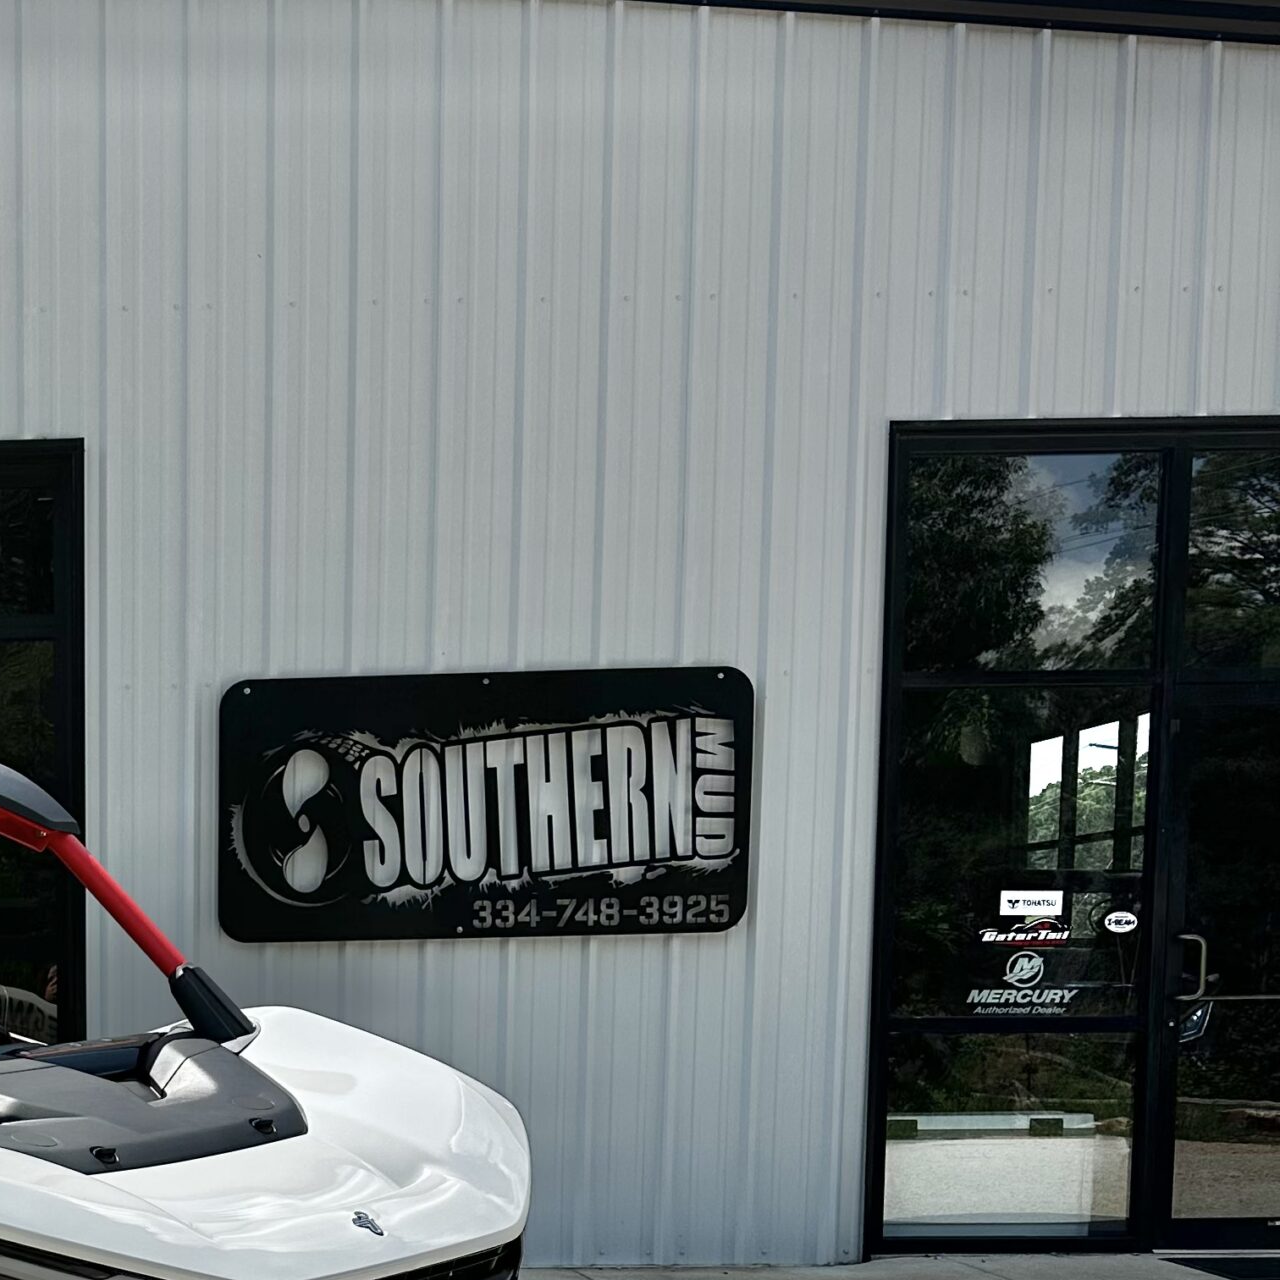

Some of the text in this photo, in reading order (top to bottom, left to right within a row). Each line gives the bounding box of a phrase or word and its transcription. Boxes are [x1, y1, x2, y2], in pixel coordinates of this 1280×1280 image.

[695, 717, 736, 857] MUD
[359, 717, 693, 888] SOUTHERN
[472, 894, 730, 929] 334-748-3925
[1022, 899, 1057, 907] TOHATSU
[966, 989, 1080, 1003] MERCURY
[973, 1006, 1067, 1014] Authorized Dealer
